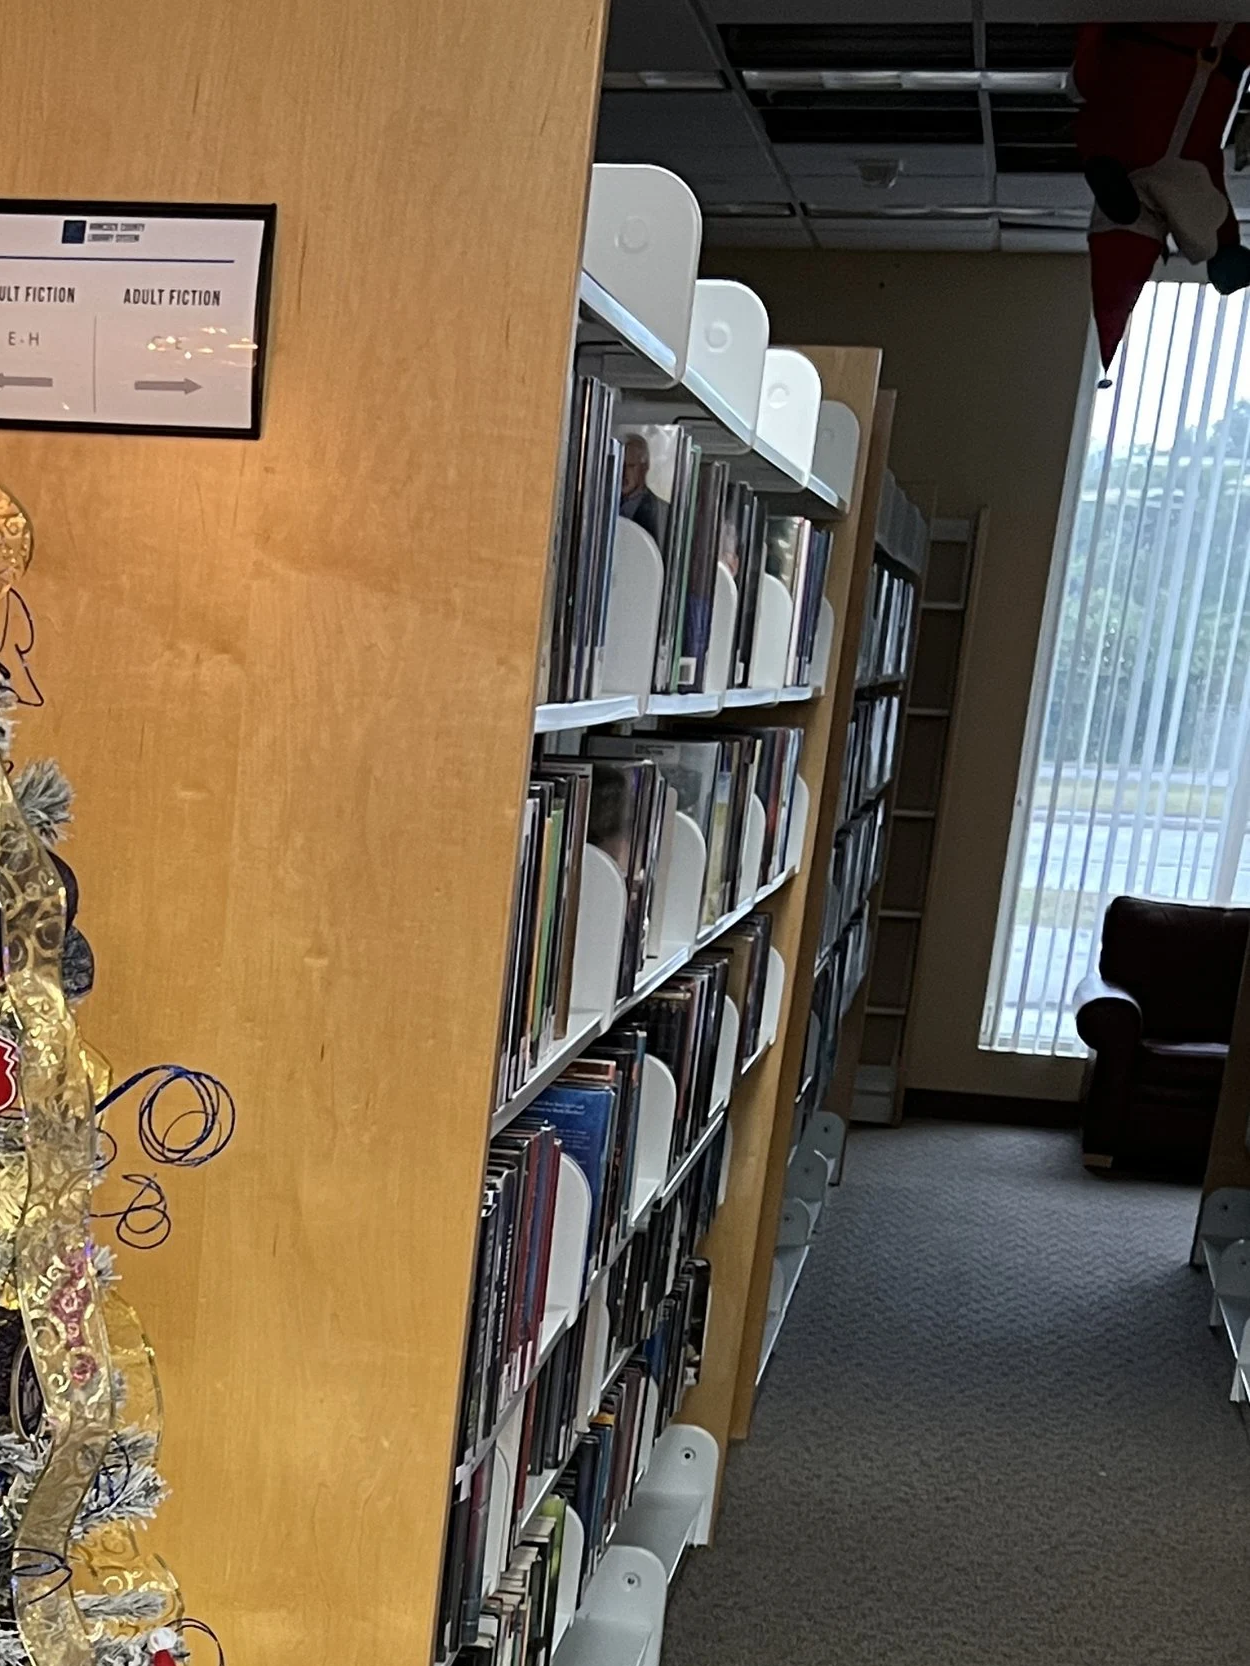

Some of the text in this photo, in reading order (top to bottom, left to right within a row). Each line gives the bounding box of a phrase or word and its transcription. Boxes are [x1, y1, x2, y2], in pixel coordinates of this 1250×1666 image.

[25, 286, 76, 303] FICTION
[123, 288, 222, 306] ADULT FICTION
[8, 331, 17, 346] E
[29, 332, 40, 346] H
